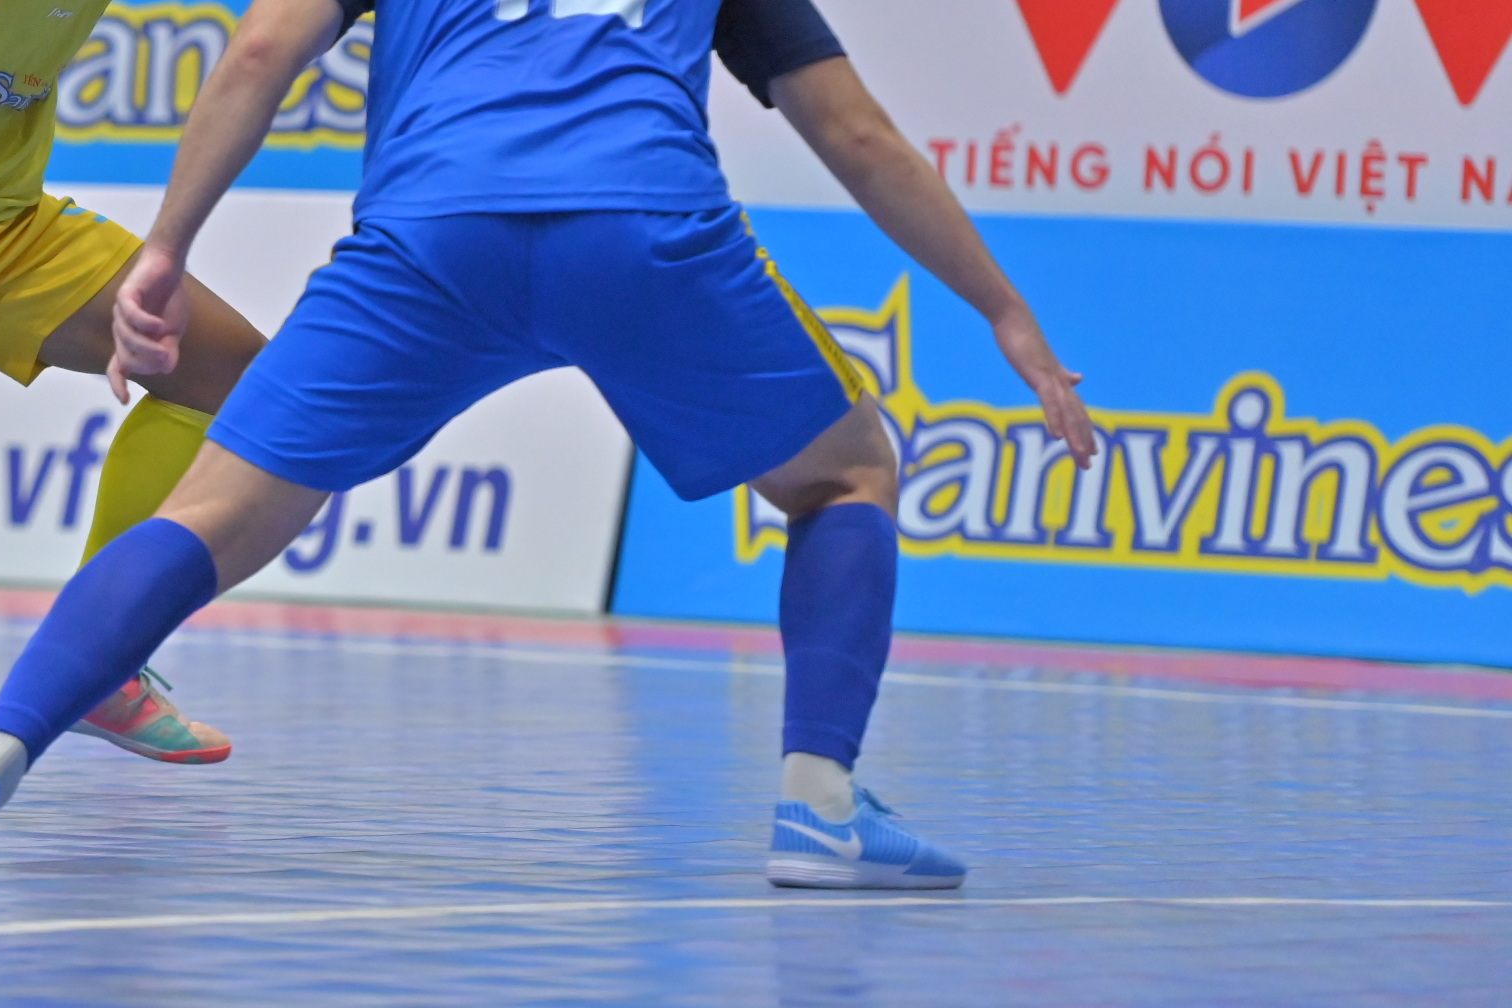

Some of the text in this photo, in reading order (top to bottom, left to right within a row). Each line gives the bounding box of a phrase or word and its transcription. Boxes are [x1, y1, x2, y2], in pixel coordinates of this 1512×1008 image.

[928, 123, 1512, 215] TIẾNG NÓI VIỆT N
